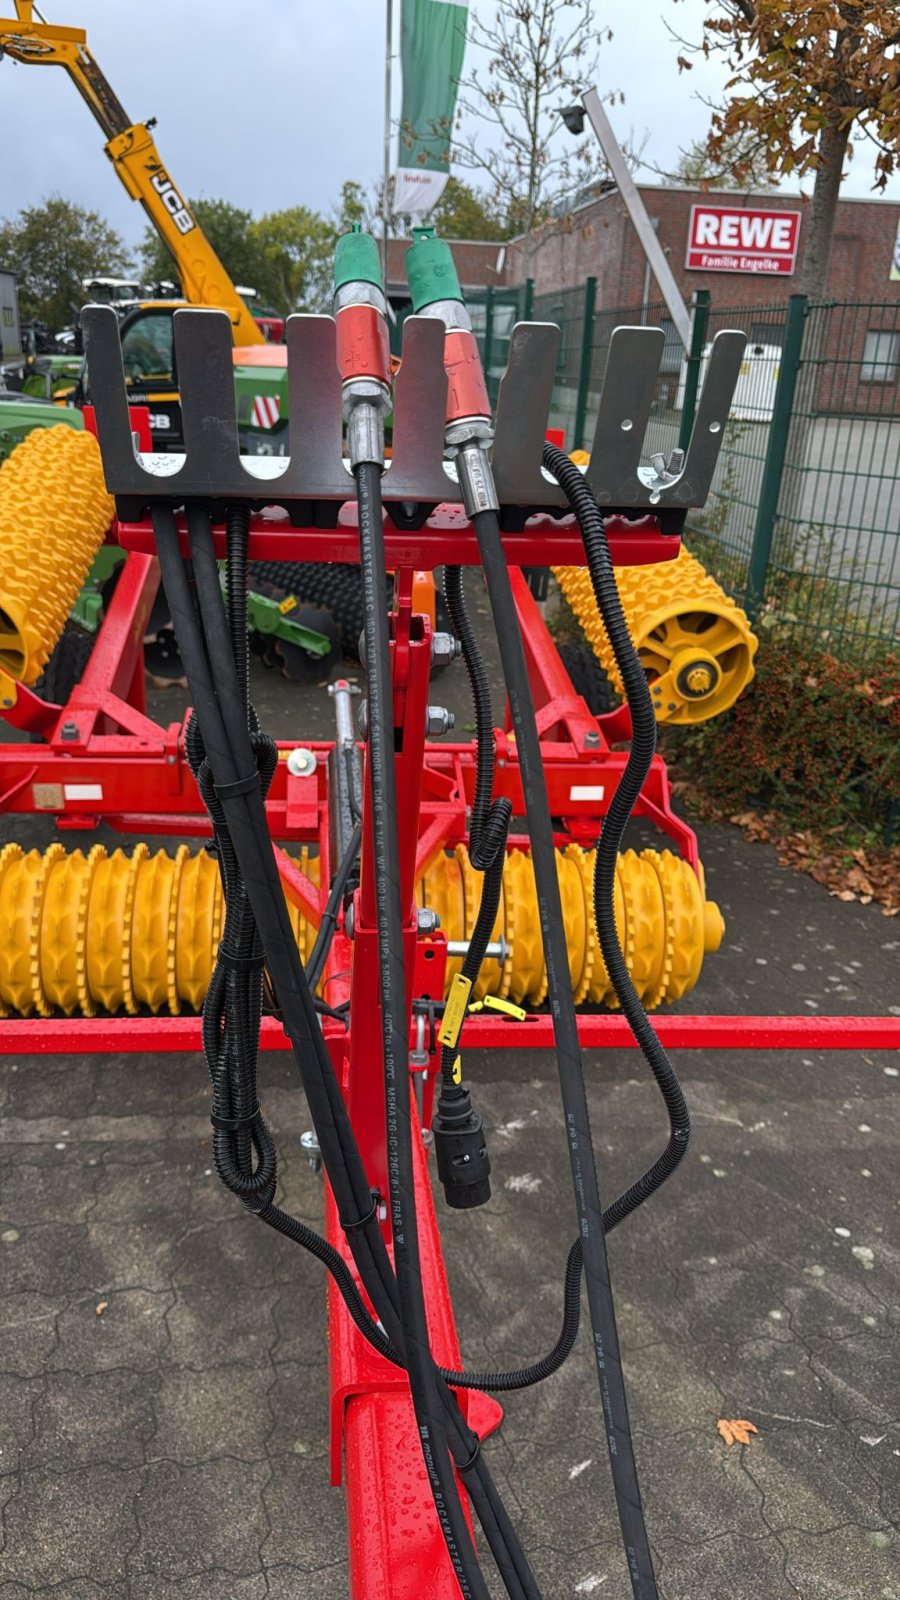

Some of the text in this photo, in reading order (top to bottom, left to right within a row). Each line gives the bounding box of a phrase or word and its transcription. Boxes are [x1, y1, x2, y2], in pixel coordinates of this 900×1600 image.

[151, 175, 195, 234] JCB
[695, 213, 793, 250] REWE
[701, 255, 780, 272] Familie Engelke
[360, 503, 374, 611] ROCKMASTER/2SC
[366, 618, 375, 633] ISO
[366, 636, 376, 662] 11237
[367, 668, 378, 681] EN
[370, 702, 379, 721] 2SC
[371, 725, 380, 743] SAE
[371, 747, 382, 781] 100R16
[373, 788, 383, 803] DN
[377, 855, 386, 871] WP
[378, 876, 387, 893] 400
[378, 895, 387, 911] bar
[380, 938, 389, 958] MPa
[382, 963, 390, 987] 5800
[382, 989, 391, 1000] psi
[386, 1087, 396, 1116] MSHA
[392, 1200, 402, 1225] FRAS
